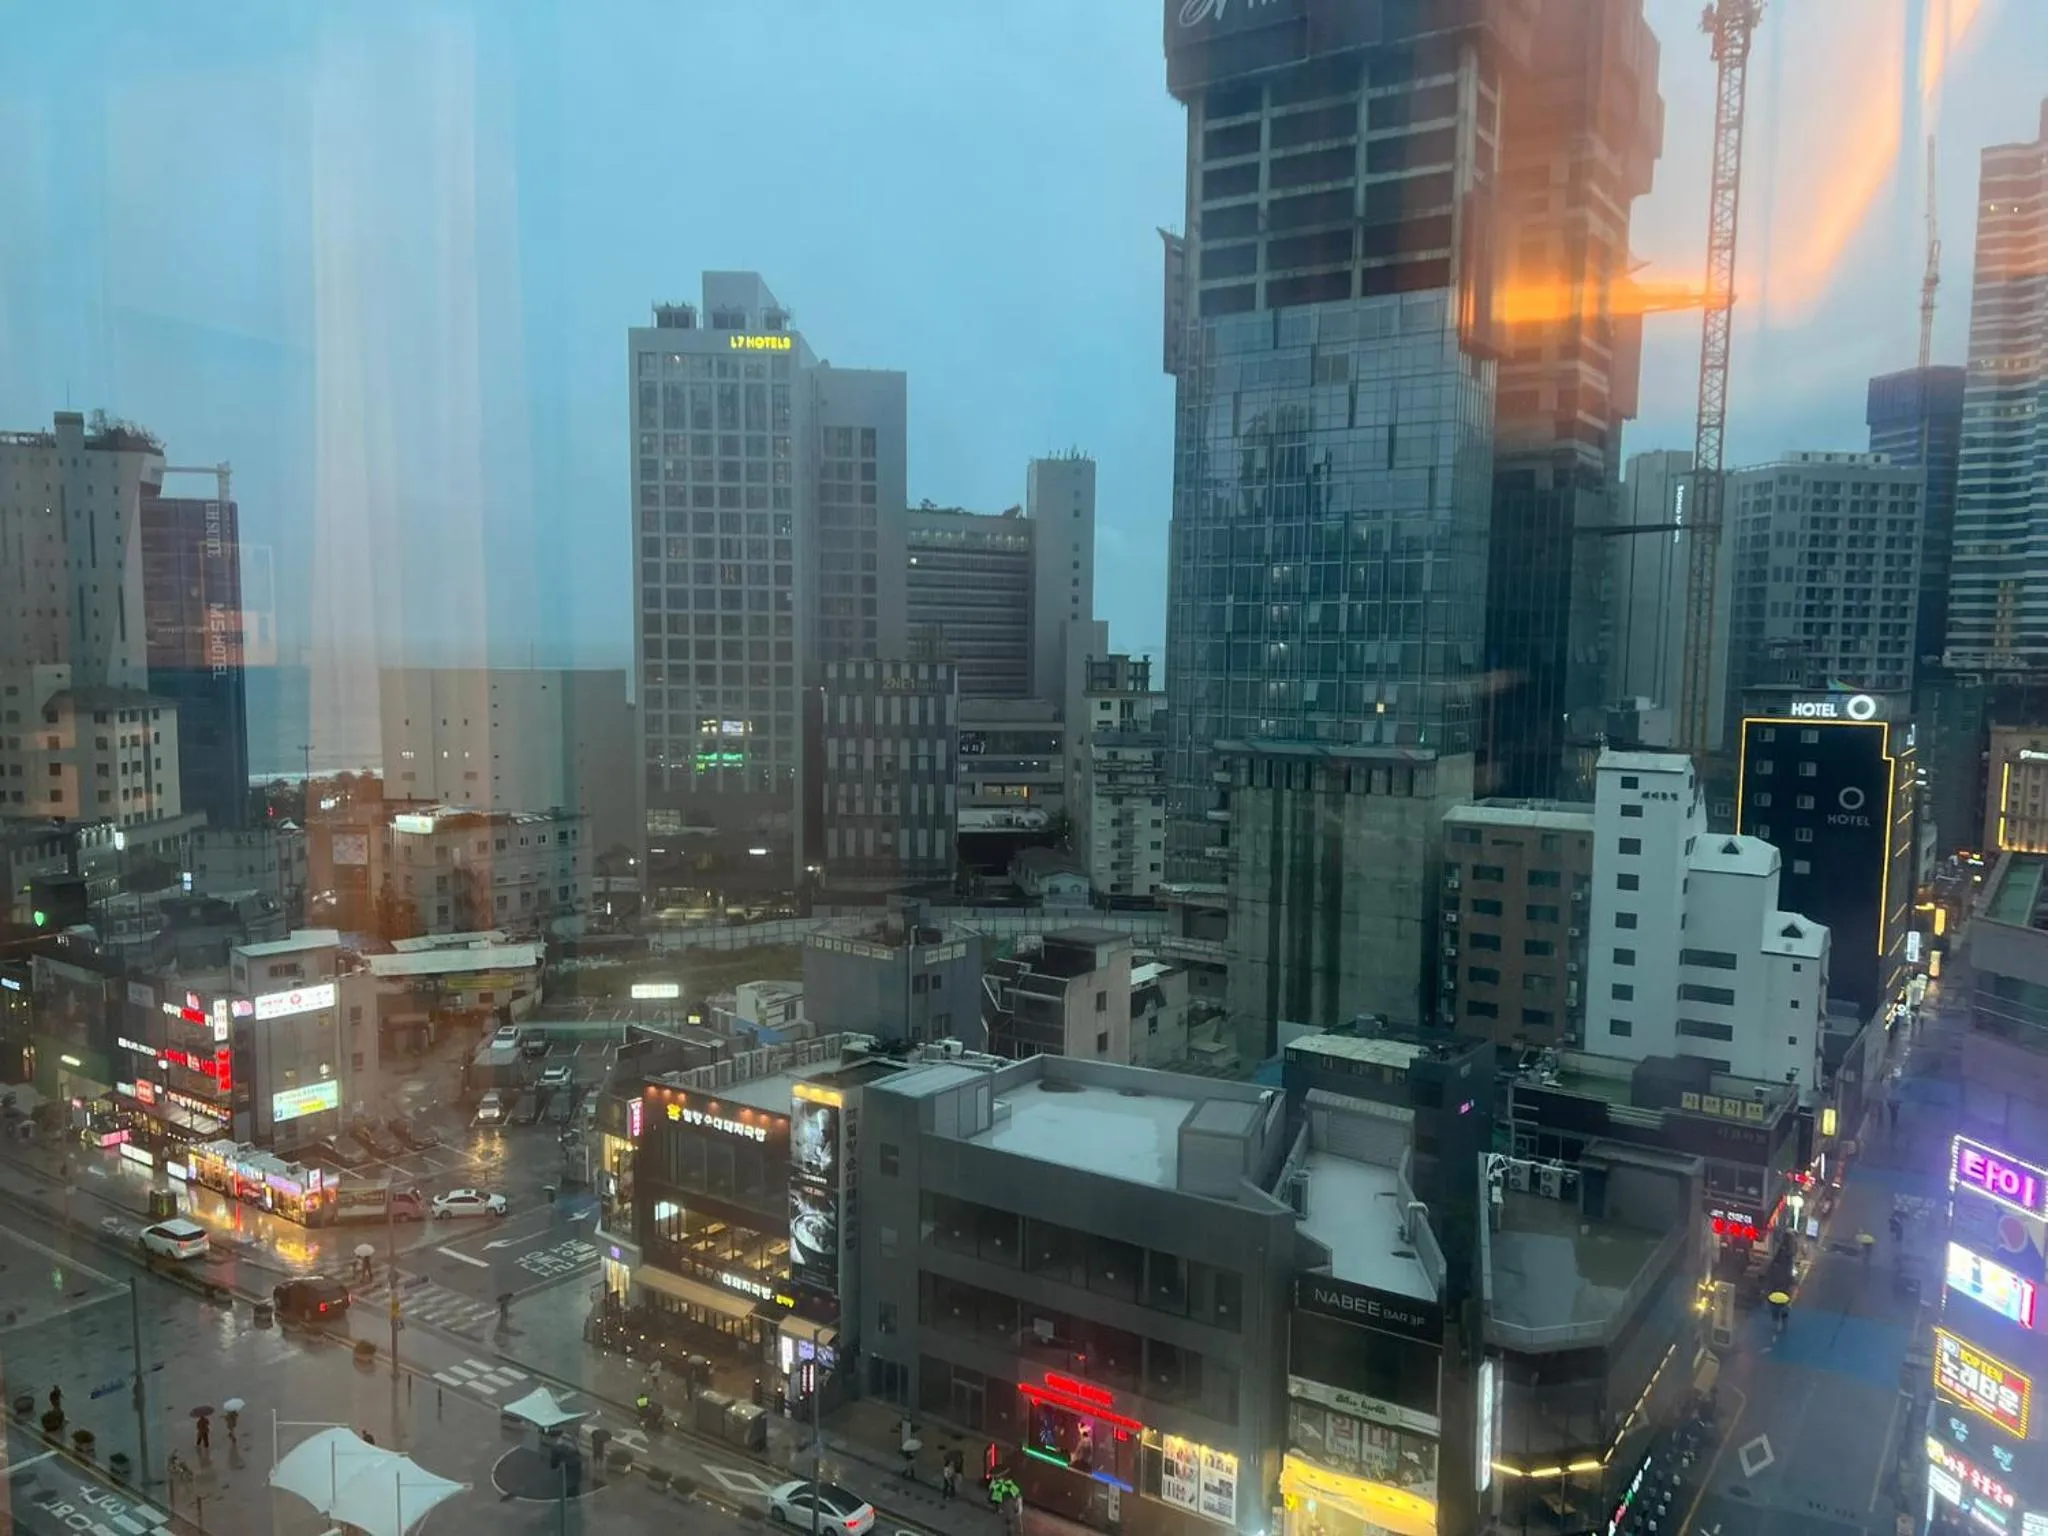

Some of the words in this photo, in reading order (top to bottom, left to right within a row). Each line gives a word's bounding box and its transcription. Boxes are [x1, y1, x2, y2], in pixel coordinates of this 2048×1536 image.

[731, 336, 745, 349] L7
[746, 336, 791, 350] HOTELS
[209, 602, 227, 632] MS
[210, 635, 228, 681] HOTEL
[1791, 702, 1838, 717] HOTEL
[1827, 814, 1870, 826] HOTEL
[1962, 1149, 2035, 1208] 타이
[1315, 1288, 1381, 1317] NABEE
[1384, 1309, 1408, 1322] BAR
[1942, 1352, 2019, 1417] 노래타운
[1981, 1361, 2003, 1384] TEN
